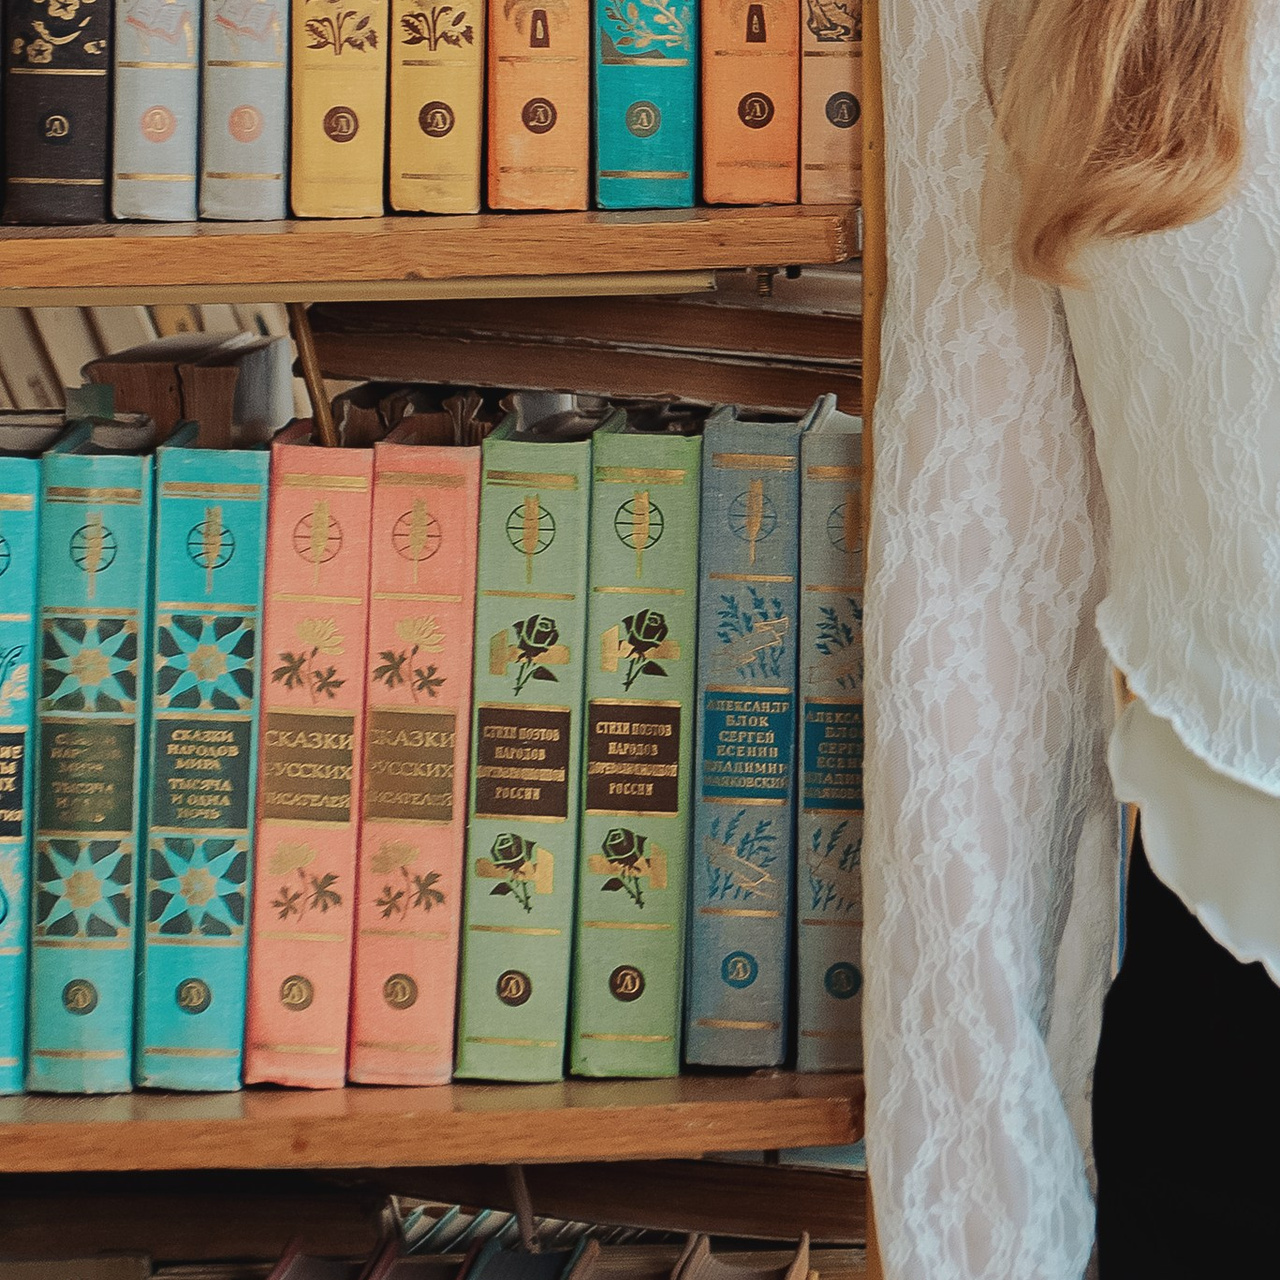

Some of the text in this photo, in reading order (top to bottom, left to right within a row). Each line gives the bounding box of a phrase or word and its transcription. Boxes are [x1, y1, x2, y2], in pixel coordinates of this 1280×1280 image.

[725, 715, 769, 727] БЛОК
[483, 725, 517, 740] СТИХИ
[596, 721, 630, 736] СТИХИ
[171, 729, 235, 742] СКАЗКИ
[265, 730, 353, 750] СКАЗКИ
[718, 730, 775, 743] СЕРГЕЙ
[716, 745, 779, 758] ЕСЕНИН
[609, 782, 654, 796] РОССИИ
